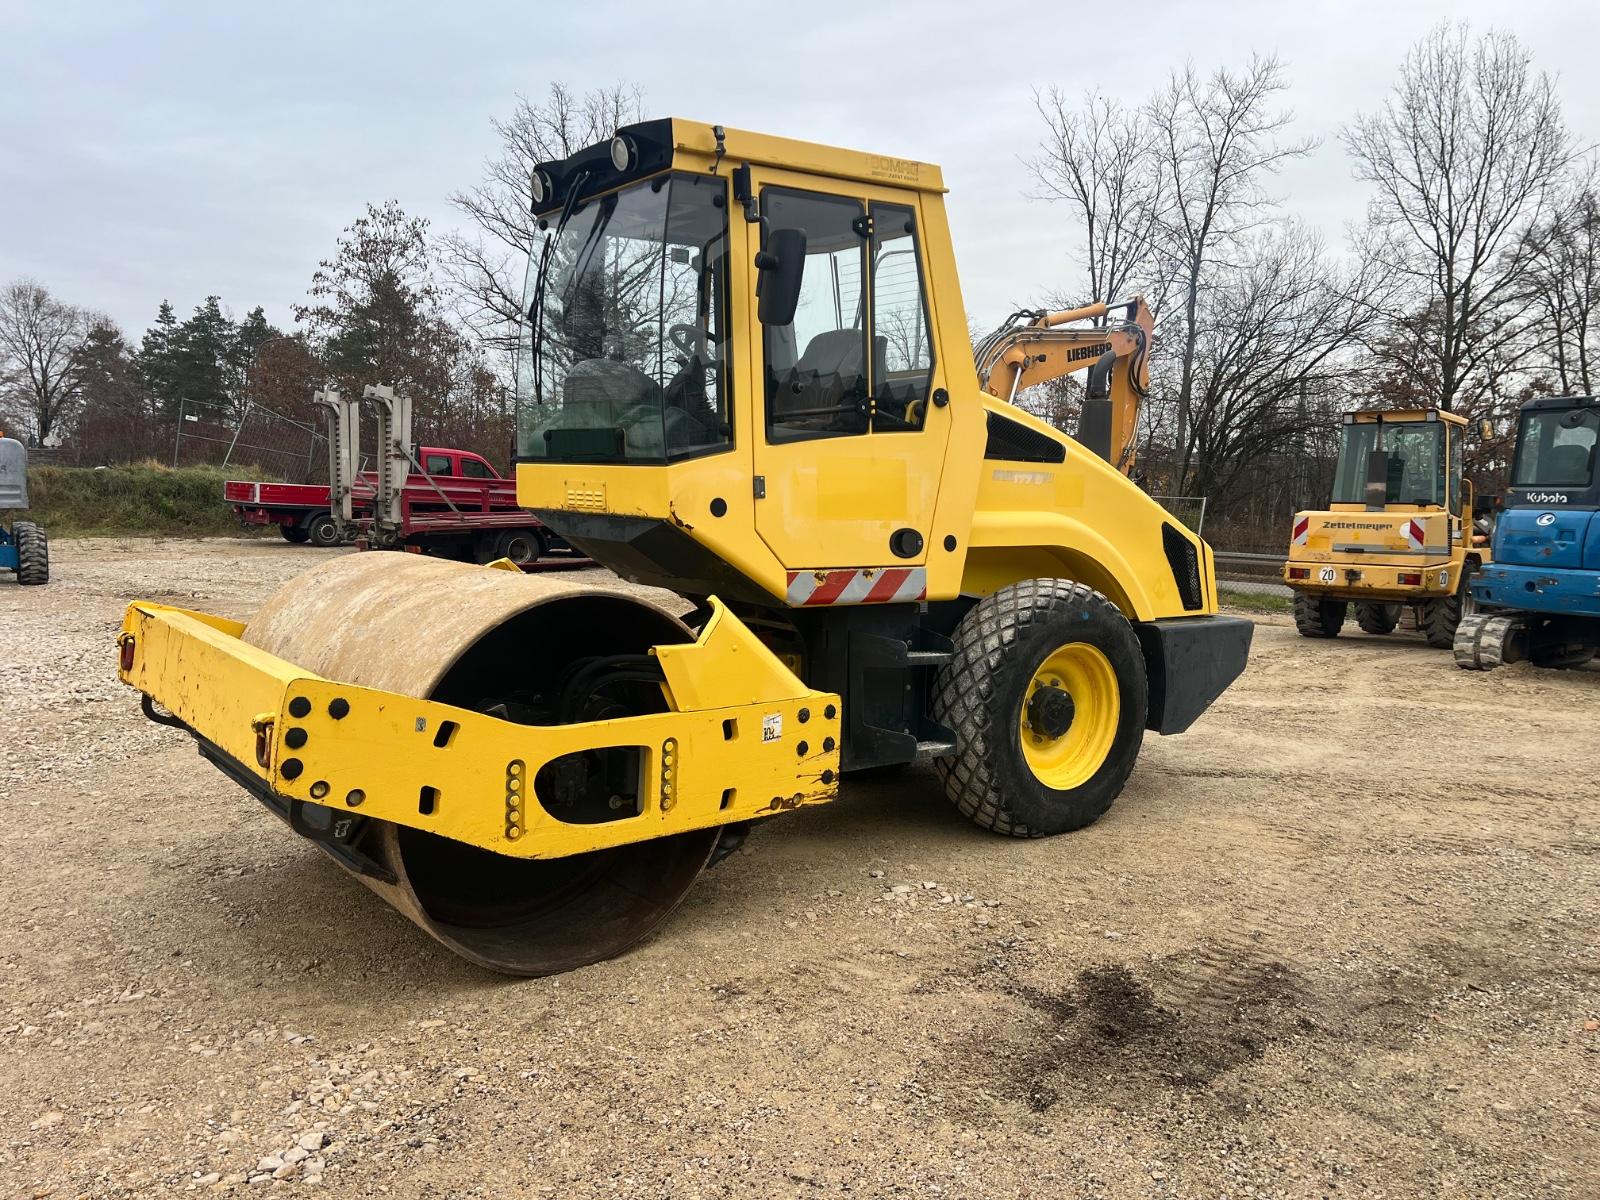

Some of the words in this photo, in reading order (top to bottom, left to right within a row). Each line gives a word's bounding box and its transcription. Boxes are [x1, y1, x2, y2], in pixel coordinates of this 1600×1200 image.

[871, 155, 919, 176] BOMAG
[1067, 342, 1112, 362] LIEBHERR
[1526, 492, 1568, 503] Kubota
[1322, 521, 1392, 531] Zettelmeyer
[1322, 569, 1334, 581] 20
[1440, 572, 1447, 585] 20
